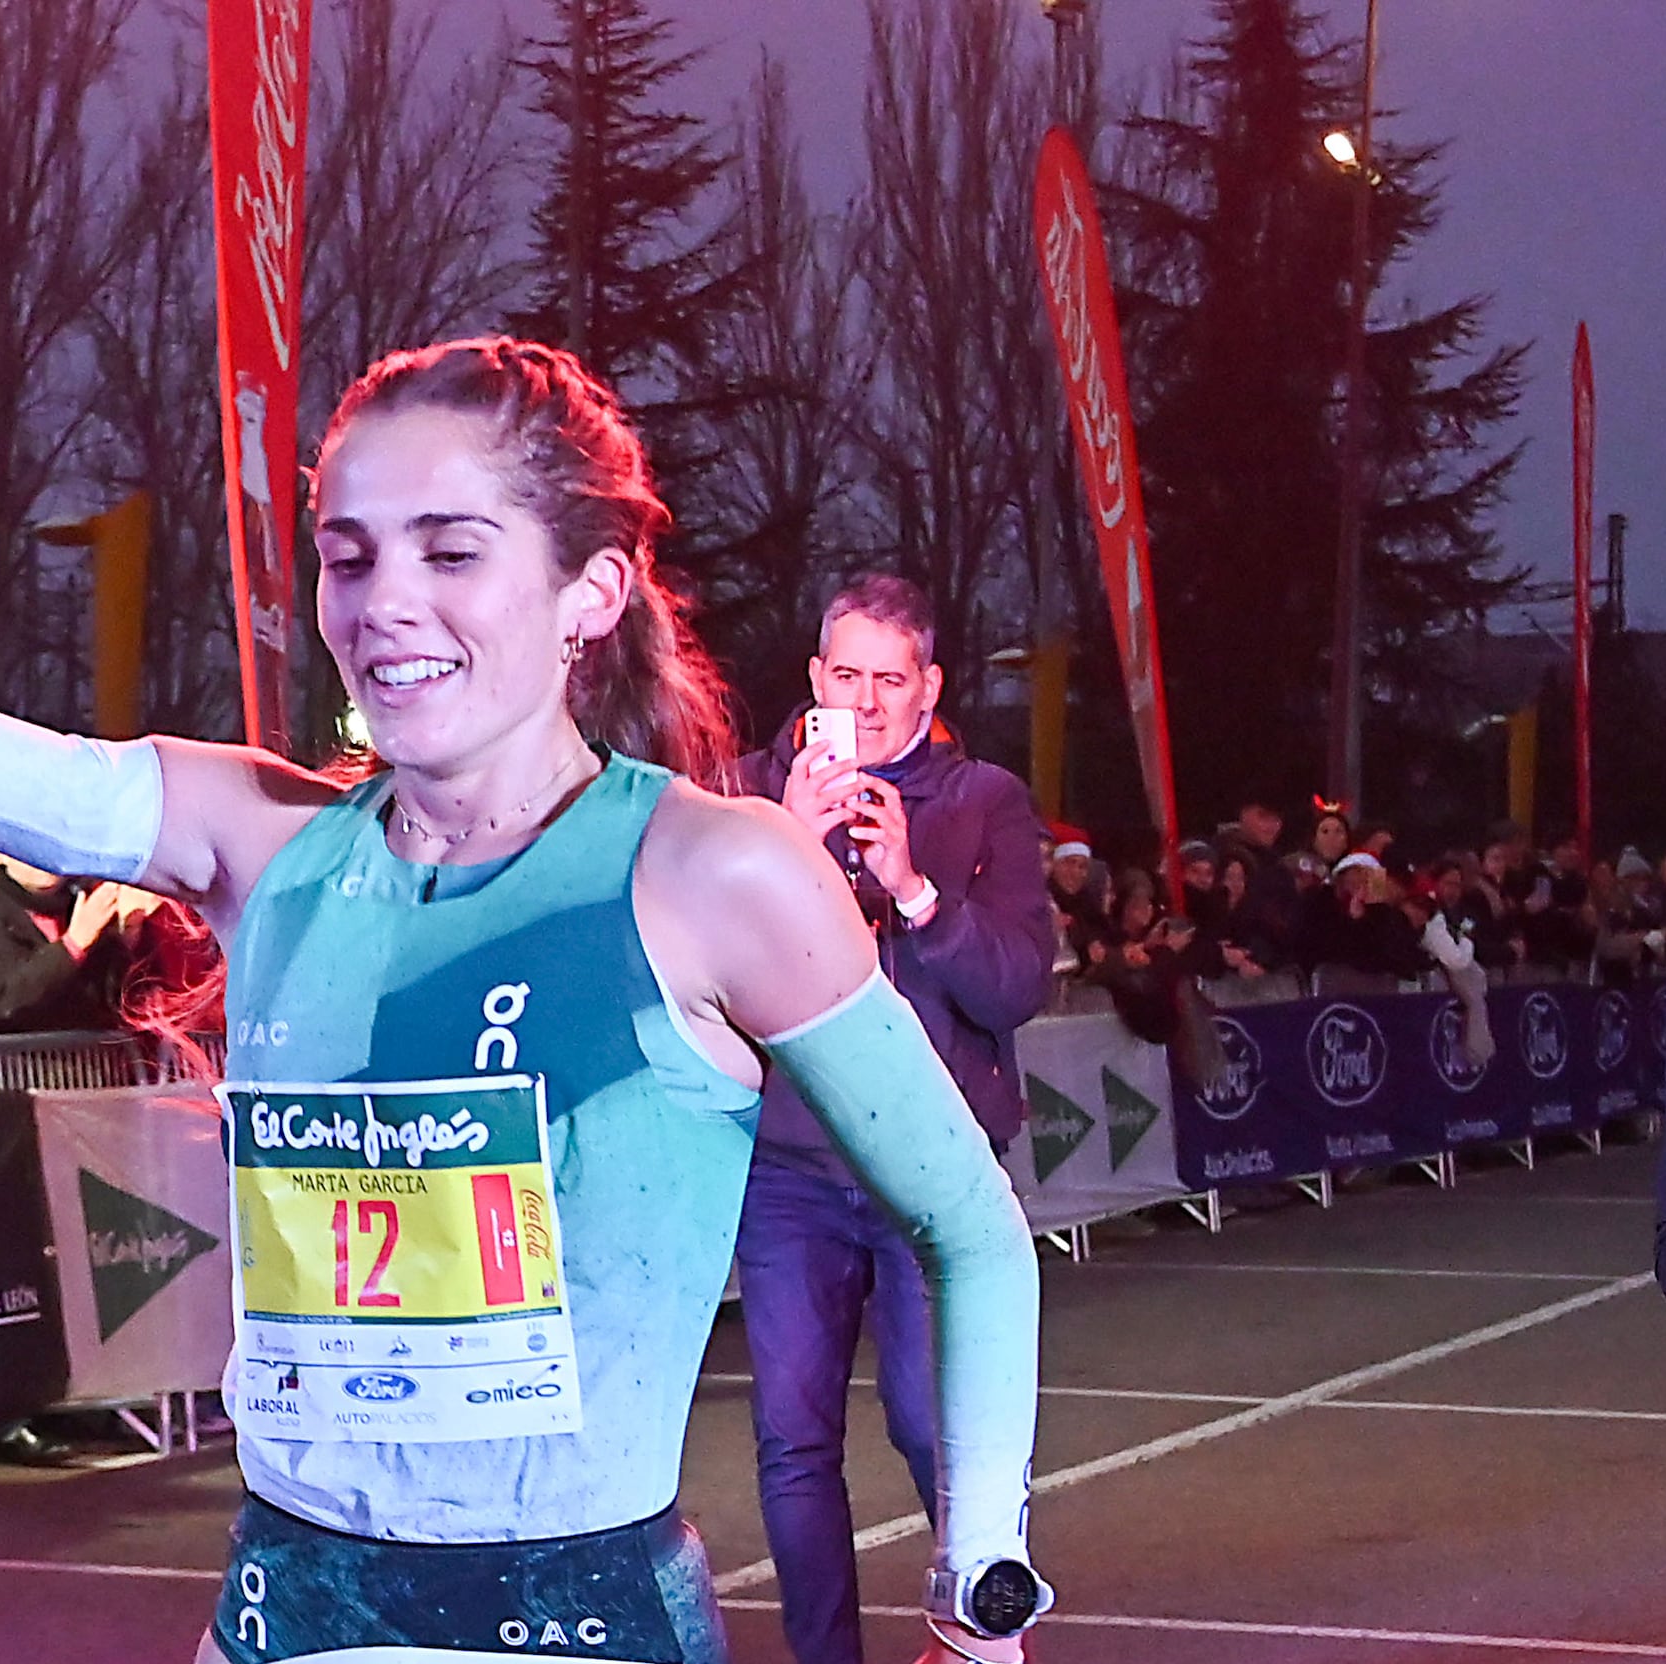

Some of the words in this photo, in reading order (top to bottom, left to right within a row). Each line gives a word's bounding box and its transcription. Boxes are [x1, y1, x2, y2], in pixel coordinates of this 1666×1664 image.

[237, 1020, 289, 1048] OAC
[251, 1101, 283, 1149] El
[282, 1104, 361, 1151] Corte
[363, 1094, 491, 1168] Inglés
[292, 1174, 350, 1194] MARTA
[359, 1174, 428, 1194] GARCIA
[331, 1199, 402, 1308] 12
[353, 1376, 407, 1399] Ford
[247, 1398, 301, 1416] LABORAL
[499, 1616, 608, 1647] OAC
